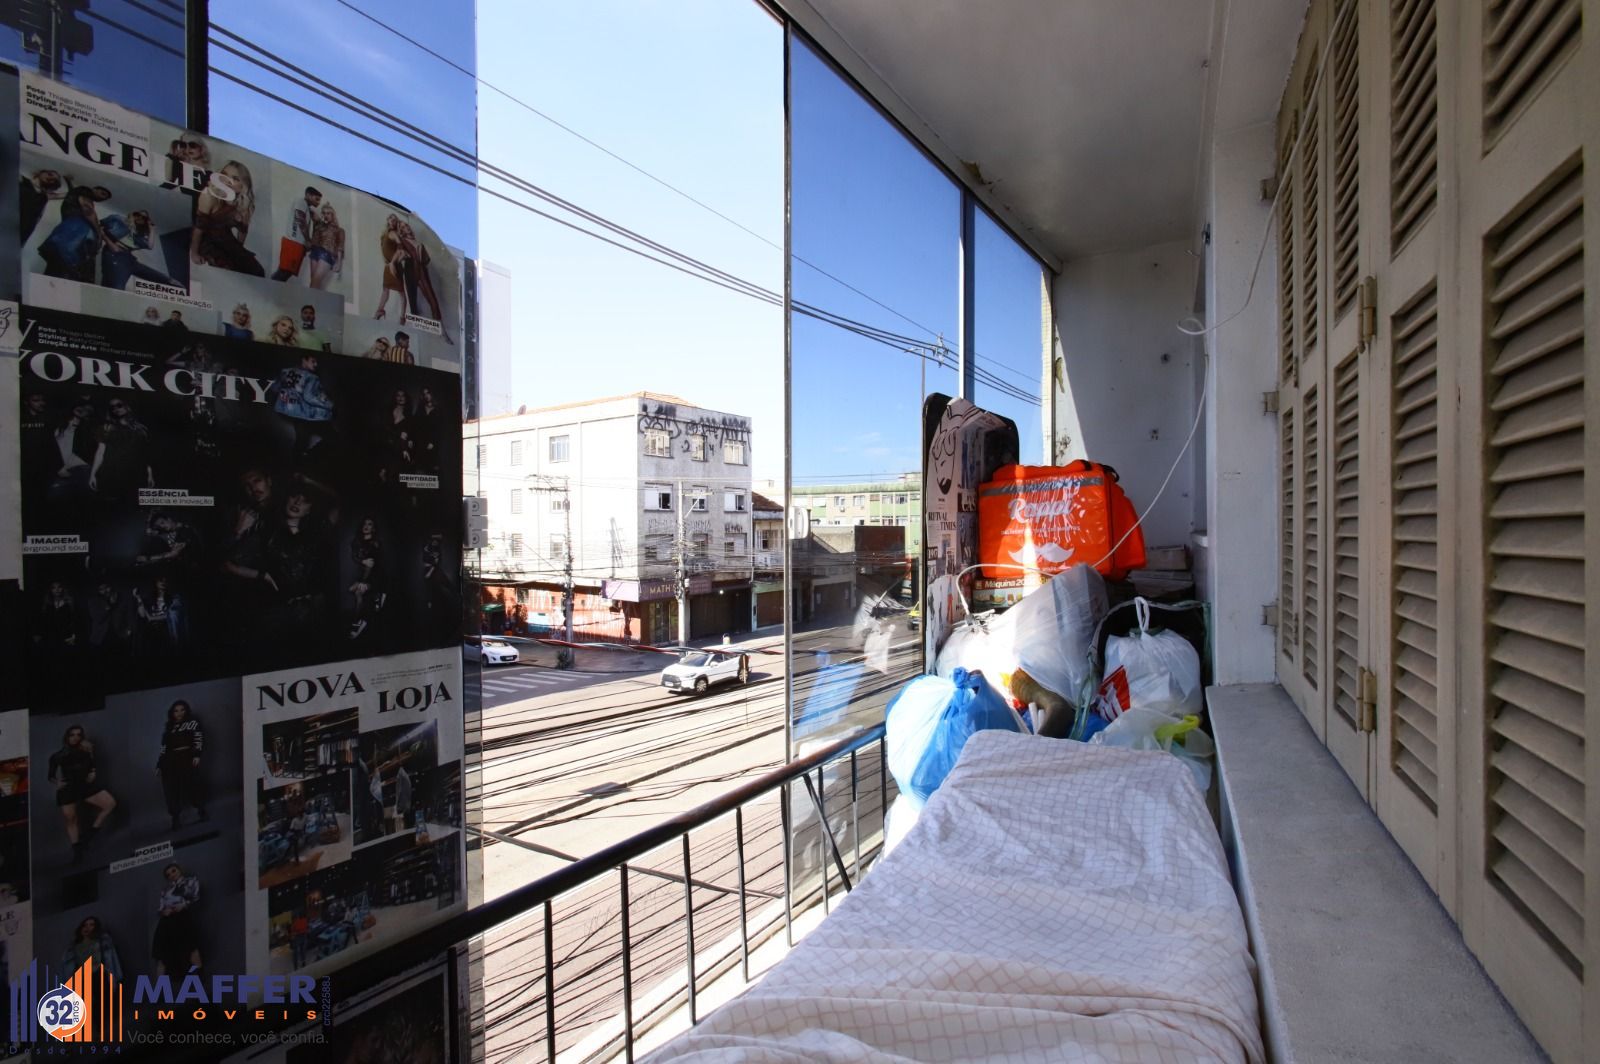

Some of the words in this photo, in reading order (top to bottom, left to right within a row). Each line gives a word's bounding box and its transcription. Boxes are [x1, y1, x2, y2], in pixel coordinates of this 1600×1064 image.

[136, 281, 186, 297] ESSÊNCIA
[163, 368, 276, 404] CITY
[139, 490, 187, 498] ESSÊNCIA
[1008, 498, 1072, 523] Rappi
[31, 537, 78, 545] IMAGEM
[67, 544, 87, 552] soul
[256, 671, 366, 711] NOVA
[377, 681, 452, 713] LOJA
[135, 843, 170, 858] PODER
